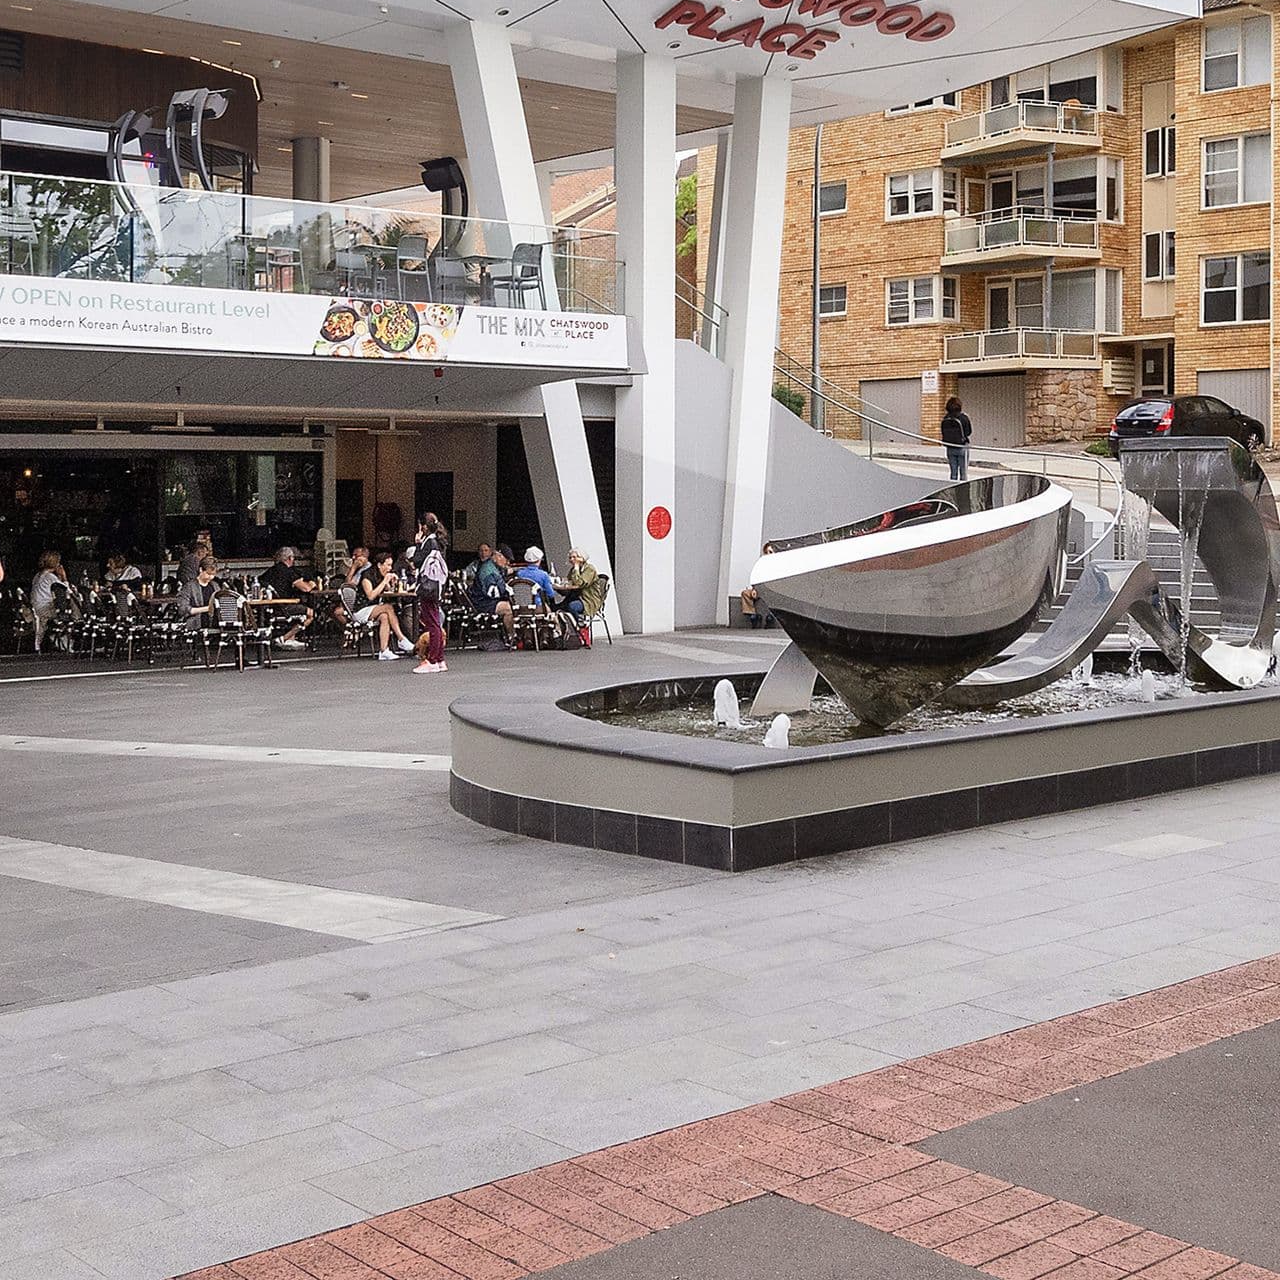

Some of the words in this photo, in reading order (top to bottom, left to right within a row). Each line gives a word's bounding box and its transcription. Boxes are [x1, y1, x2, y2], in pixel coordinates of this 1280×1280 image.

[12, 287, 72, 307] OPEN
[78, 295, 103, 308] on
[110, 294, 217, 315] Restaurant
[223, 300, 270, 318] Level
[19, 317, 26, 326] a
[29, 316, 75, 328] modern
[78, 317, 119, 330] Korean
[122, 320, 178, 334] Australian
[181, 322, 213, 335] Bistro
[476, 315, 508, 336] THE
[514, 317, 545, 338] MIX
[550, 319, 609, 330] CHATSWOOD
[565, 331, 594, 339] PLACE
